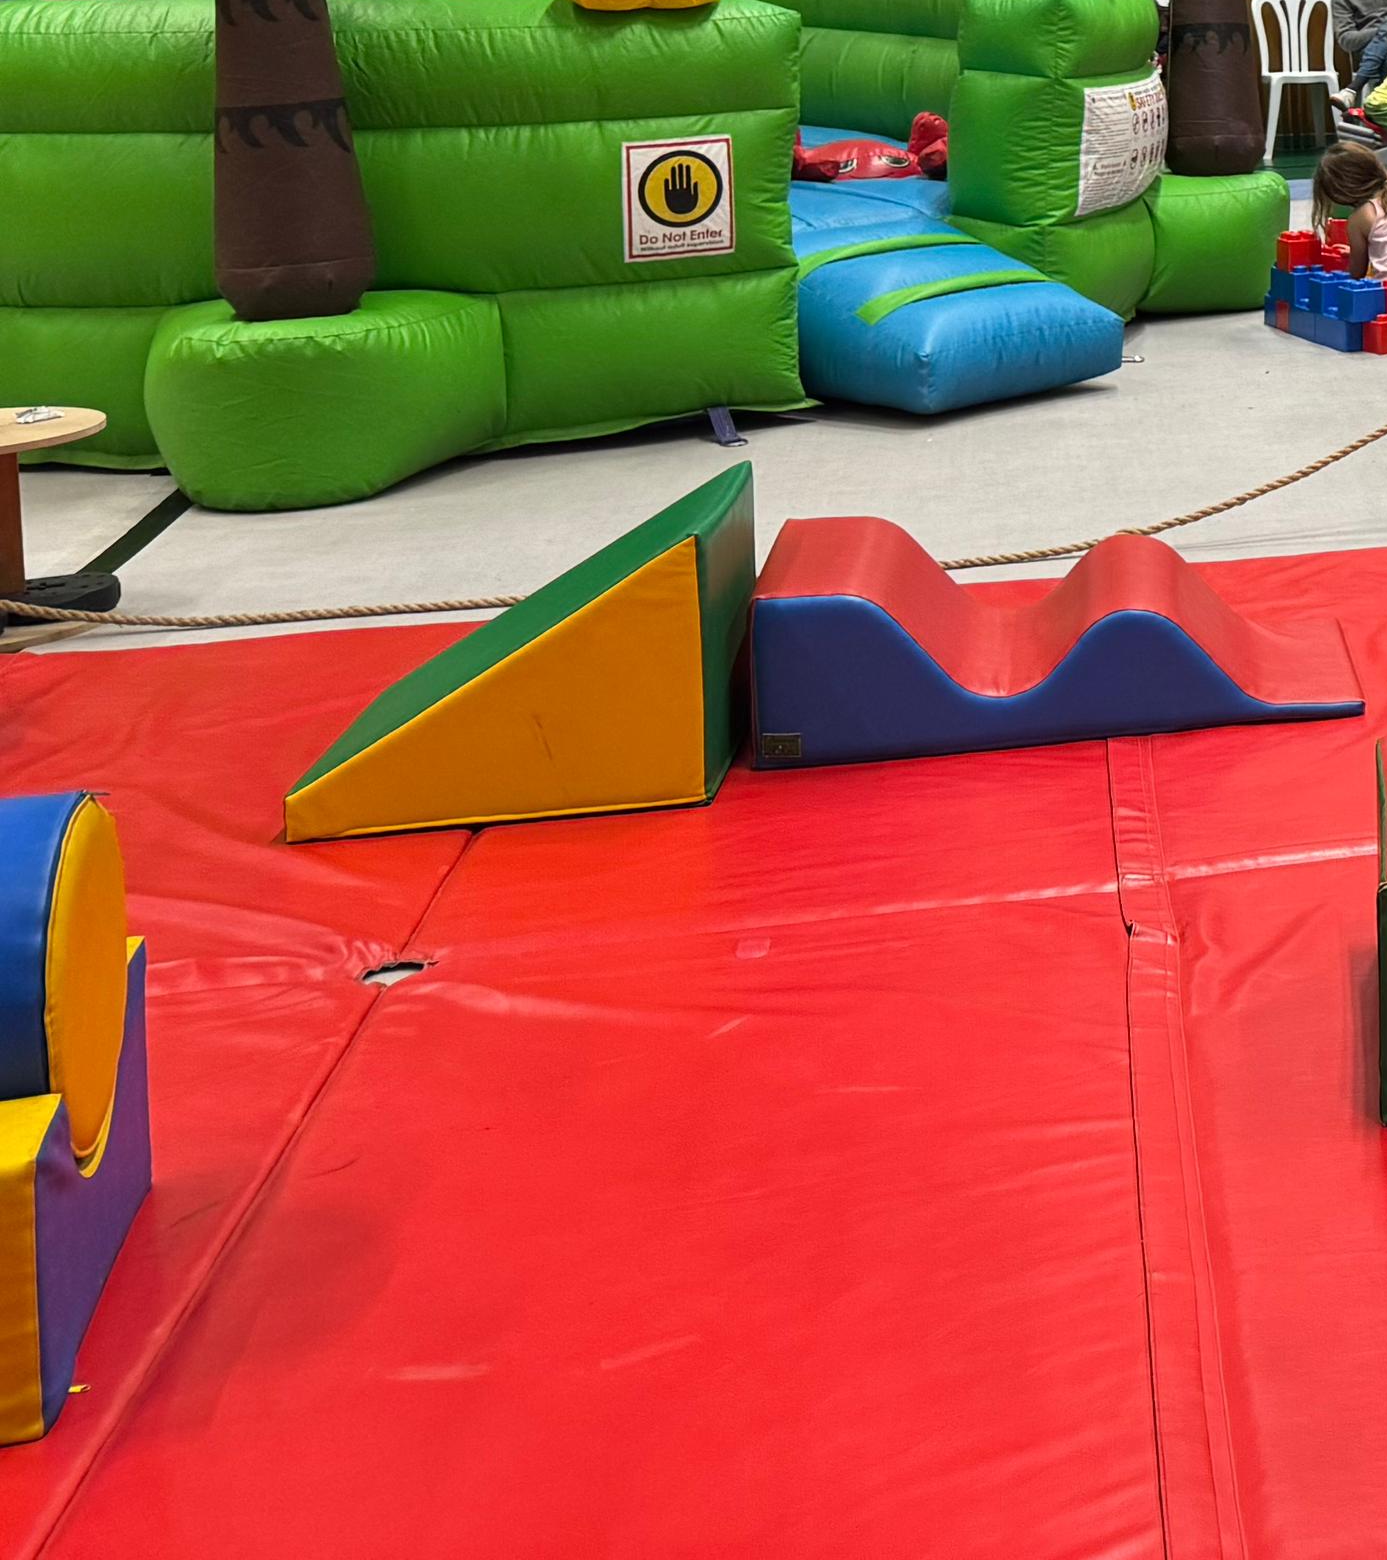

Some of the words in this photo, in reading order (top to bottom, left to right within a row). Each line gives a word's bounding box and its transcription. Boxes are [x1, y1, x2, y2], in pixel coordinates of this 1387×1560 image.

[639, 233, 659, 246] Do
[662, 230, 686, 244] Not
[690, 228, 723, 241] Enter
